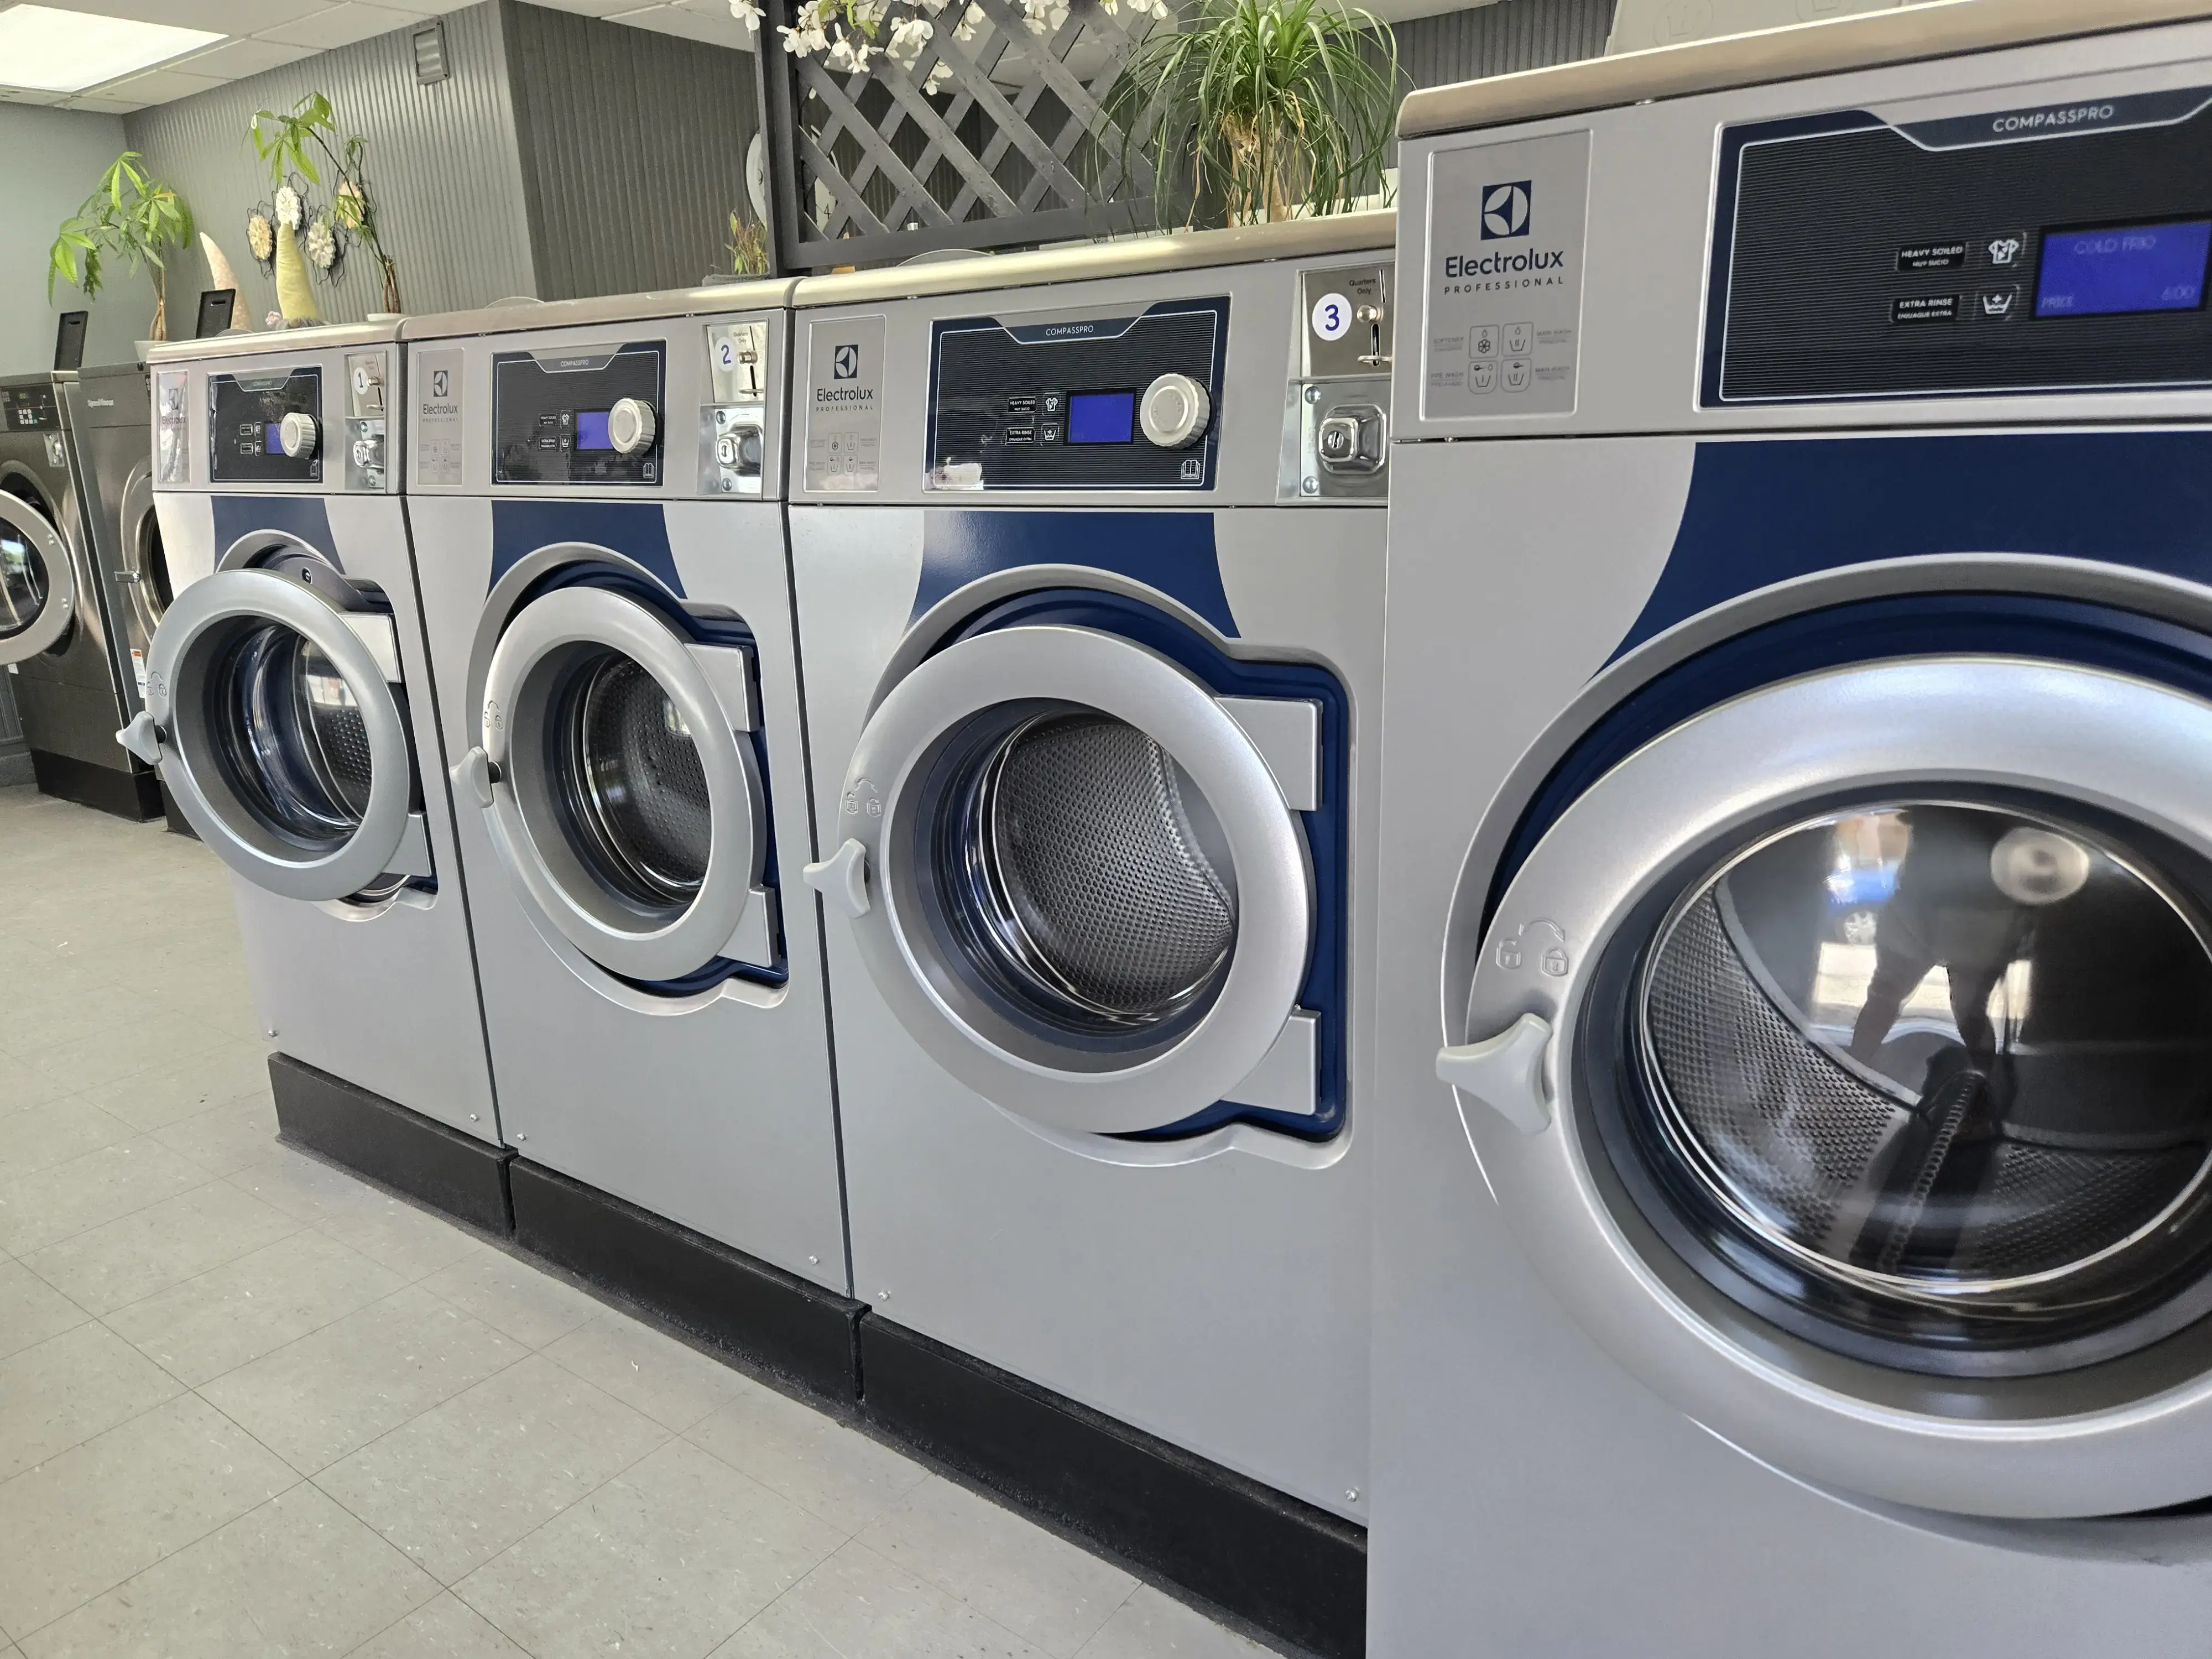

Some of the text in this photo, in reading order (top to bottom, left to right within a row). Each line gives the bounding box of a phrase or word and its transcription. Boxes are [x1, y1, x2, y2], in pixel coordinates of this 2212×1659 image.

[1992, 104, 2114, 133] COMPASSPRO
[823, 204, 831, 220] 4
[1901, 246, 1963, 258] HEAVY SOILED
[1445, 248, 1564, 278] Electrolux
[1349, 278, 1376, 286] Quarters
[1444, 276, 1563, 295] PROFESSIONAL
[1899, 298, 1953, 309] EXTRA RINSE
[1324, 304, 1340, 331] 3
[1046, 325, 1094, 336] COMPASSPRO
[721, 344, 732, 365] 2
[358, 372, 364, 388] 1
[817, 386, 874, 402] Electrolux
[422, 403, 458, 414] Electrolux
